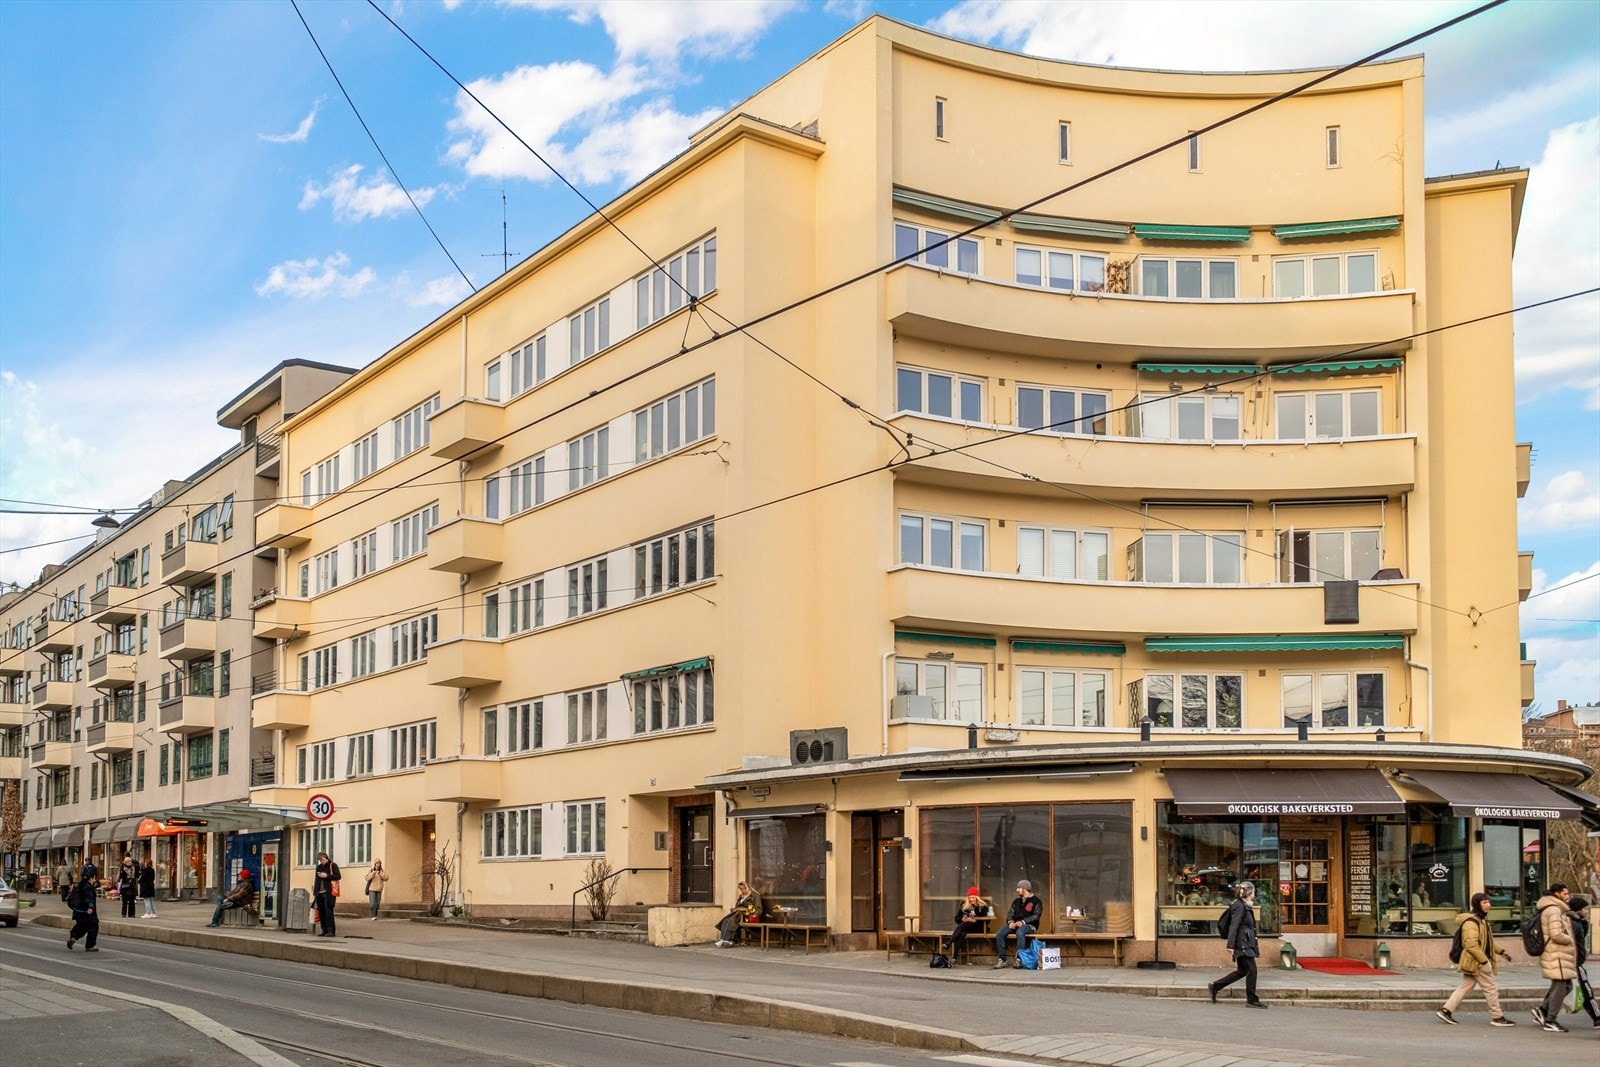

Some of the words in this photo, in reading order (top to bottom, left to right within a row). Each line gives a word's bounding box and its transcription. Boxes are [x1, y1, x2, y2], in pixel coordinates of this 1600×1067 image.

[312, 800, 330, 815] 30
[1227, 804, 1280, 814] ØKOLOGISK
[1281, 804, 1354, 813] BAKEVERKSTED
[1474, 808, 1511, 816] ØKOLOGISK
[1512, 809, 1560, 818] BAKEVERKSTED
[1351, 866, 1370, 874] FERSKT
